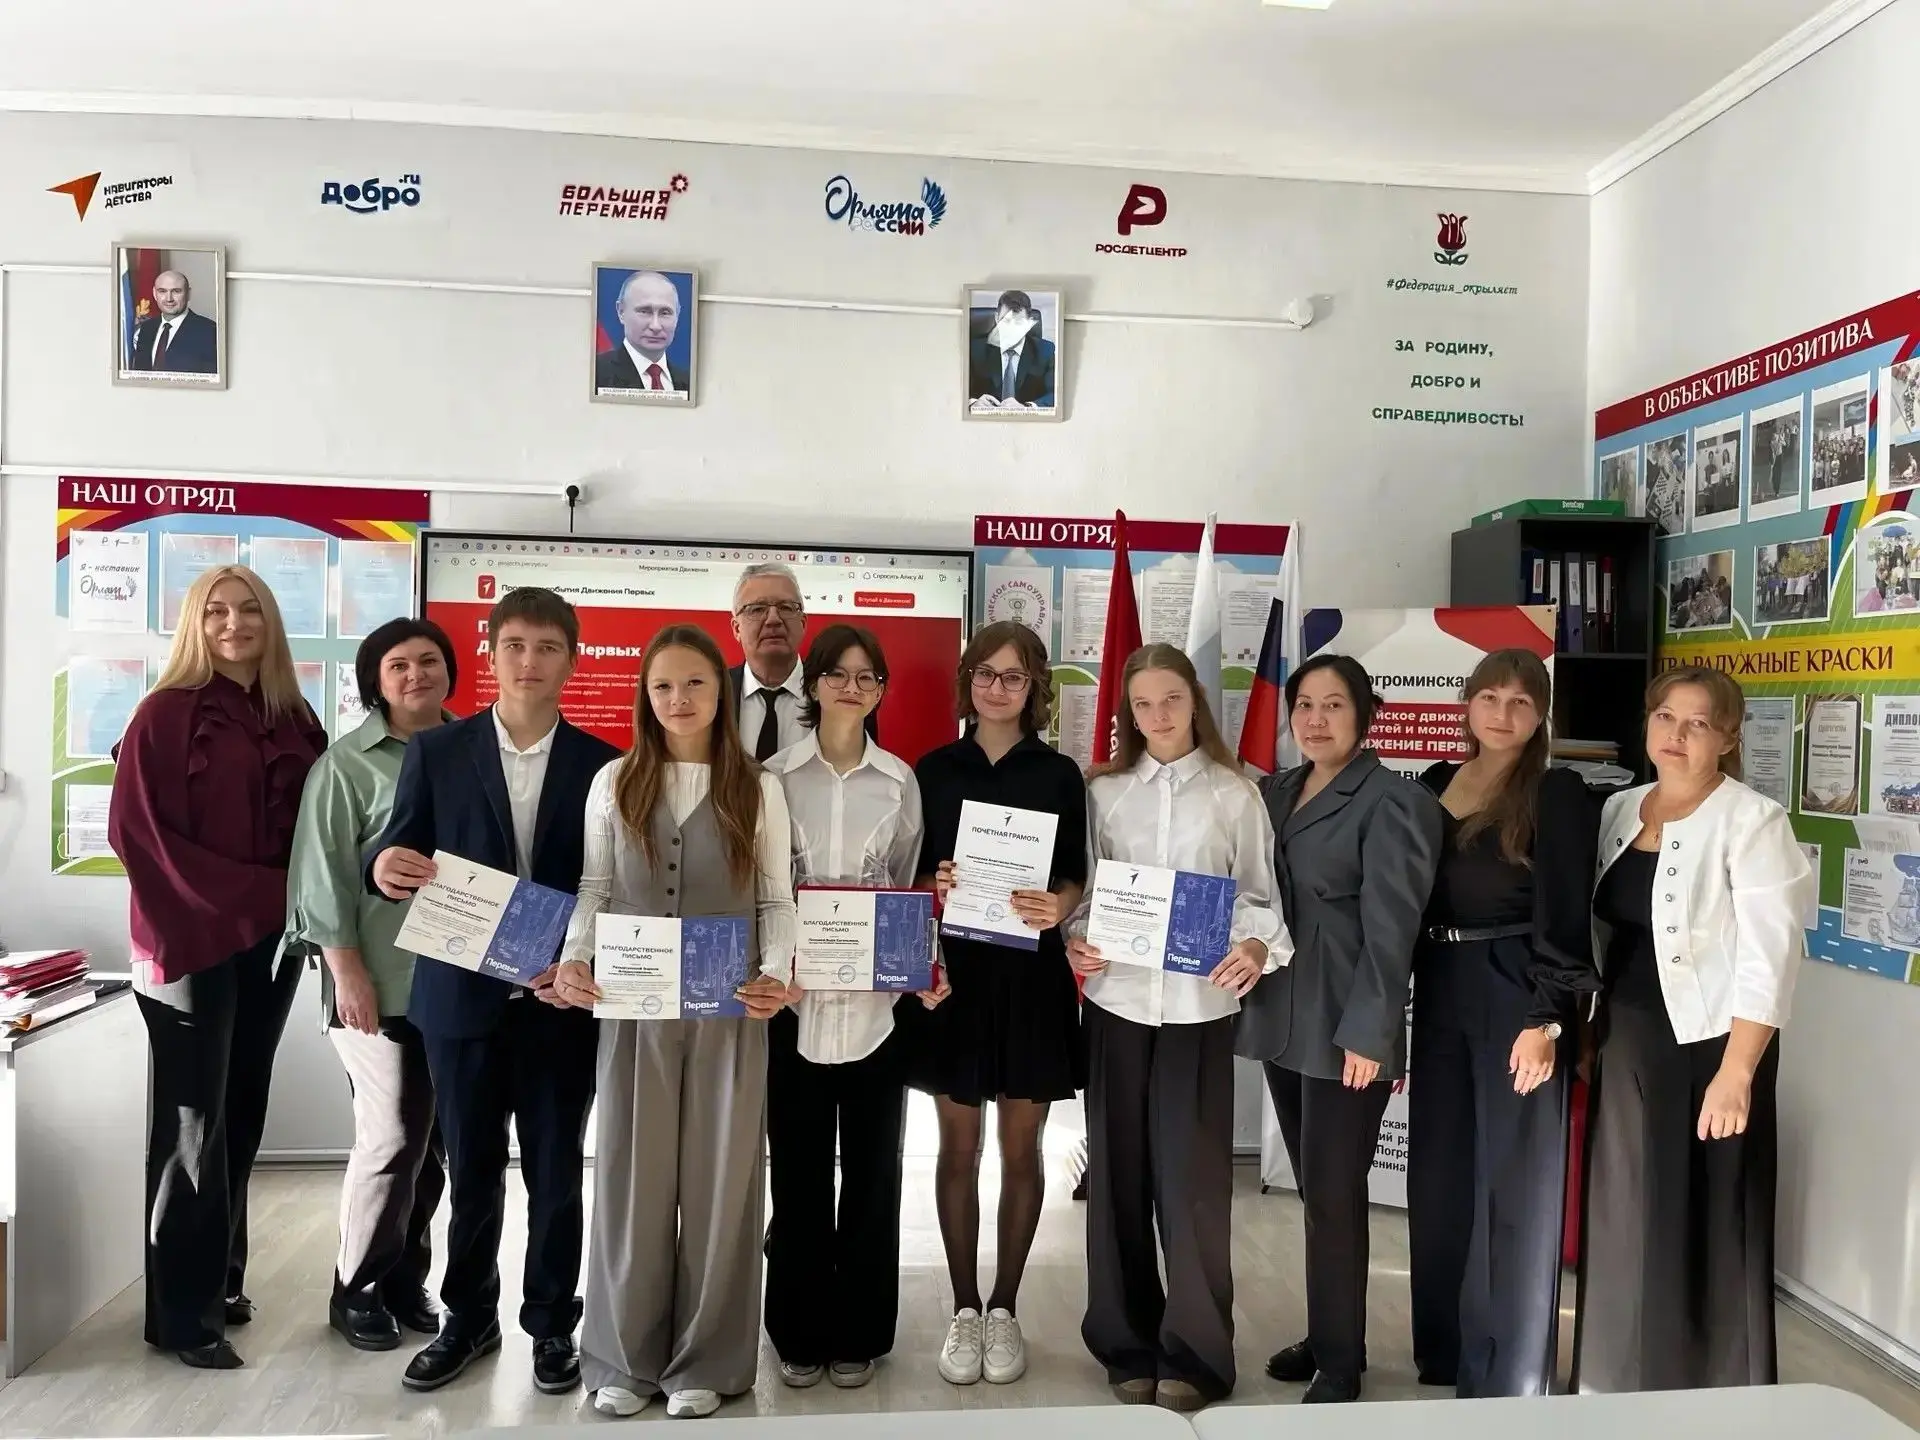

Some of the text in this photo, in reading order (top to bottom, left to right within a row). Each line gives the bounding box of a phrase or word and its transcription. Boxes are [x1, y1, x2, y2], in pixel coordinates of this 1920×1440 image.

[103, 174, 174, 196] НАВИГАТОРЫ
[104, 189, 152, 210] ДЕТСТВА
[561, 184, 672, 208] БОЛЬШАЯ
[825, 175, 926, 224] Орлята
[559, 198, 669, 221] ПЕРЕМЕНА
[1095, 242, 1188, 258] РОСДЕТЦЕНТР
[1394, 339, 1494, 358] ЗА РОДИНУ,
[1645, 317, 1875, 418] В ОБЪЕКТИВЕ ПОЗИТИВА
[1411, 374, 1482, 390] ДОБРО И
[1371, 407, 1525, 428] СПРАВЕДЛИВОСТЬ!
[72, 482, 236, 513] НАШ ОТРЯД
[986, 520, 1043, 542] НАШ
[94, 565, 140, 573] наставник
[580, 586, 623, 596] Движения
[624, 588, 656, 597] Первых
[1806, 645, 1894, 672] КРАСКИ
[1369, 674, 1467, 690] огроминска
[1375, 709, 1467, 723] йское движе
[1367, 723, 1466, 738] етей и молод
[1360, 738, 1423, 751] ИЖЕНИЕ
[1008, 832, 1040, 844] ГРАМОТА
[429, 881, 501, 909] БЛАГОДАРСТВЕННОЕ
[446, 894, 477, 908] ПИСЬМО
[1096, 887, 1168, 904] БЛАГОДАРСТВЕННОЕ
[1115, 896, 1146, 907] ПИСЬМО
[601, 944, 674, 954] БЛАГОДАРСТВЕННОЕ
[621, 952, 653, 961] ПИСЬМО
[485, 957, 520, 976] Первые
[1167, 952, 1201, 967] Первые
[876, 973, 909, 984] Первые
[684, 1001, 720, 1012] Первые
[1381, 1119, 1407, 1130] ская
[1378, 1131, 1393, 1143] ий
[1376, 1144, 1409, 1158] Погро
[1372, 1159, 1405, 1172] енина
